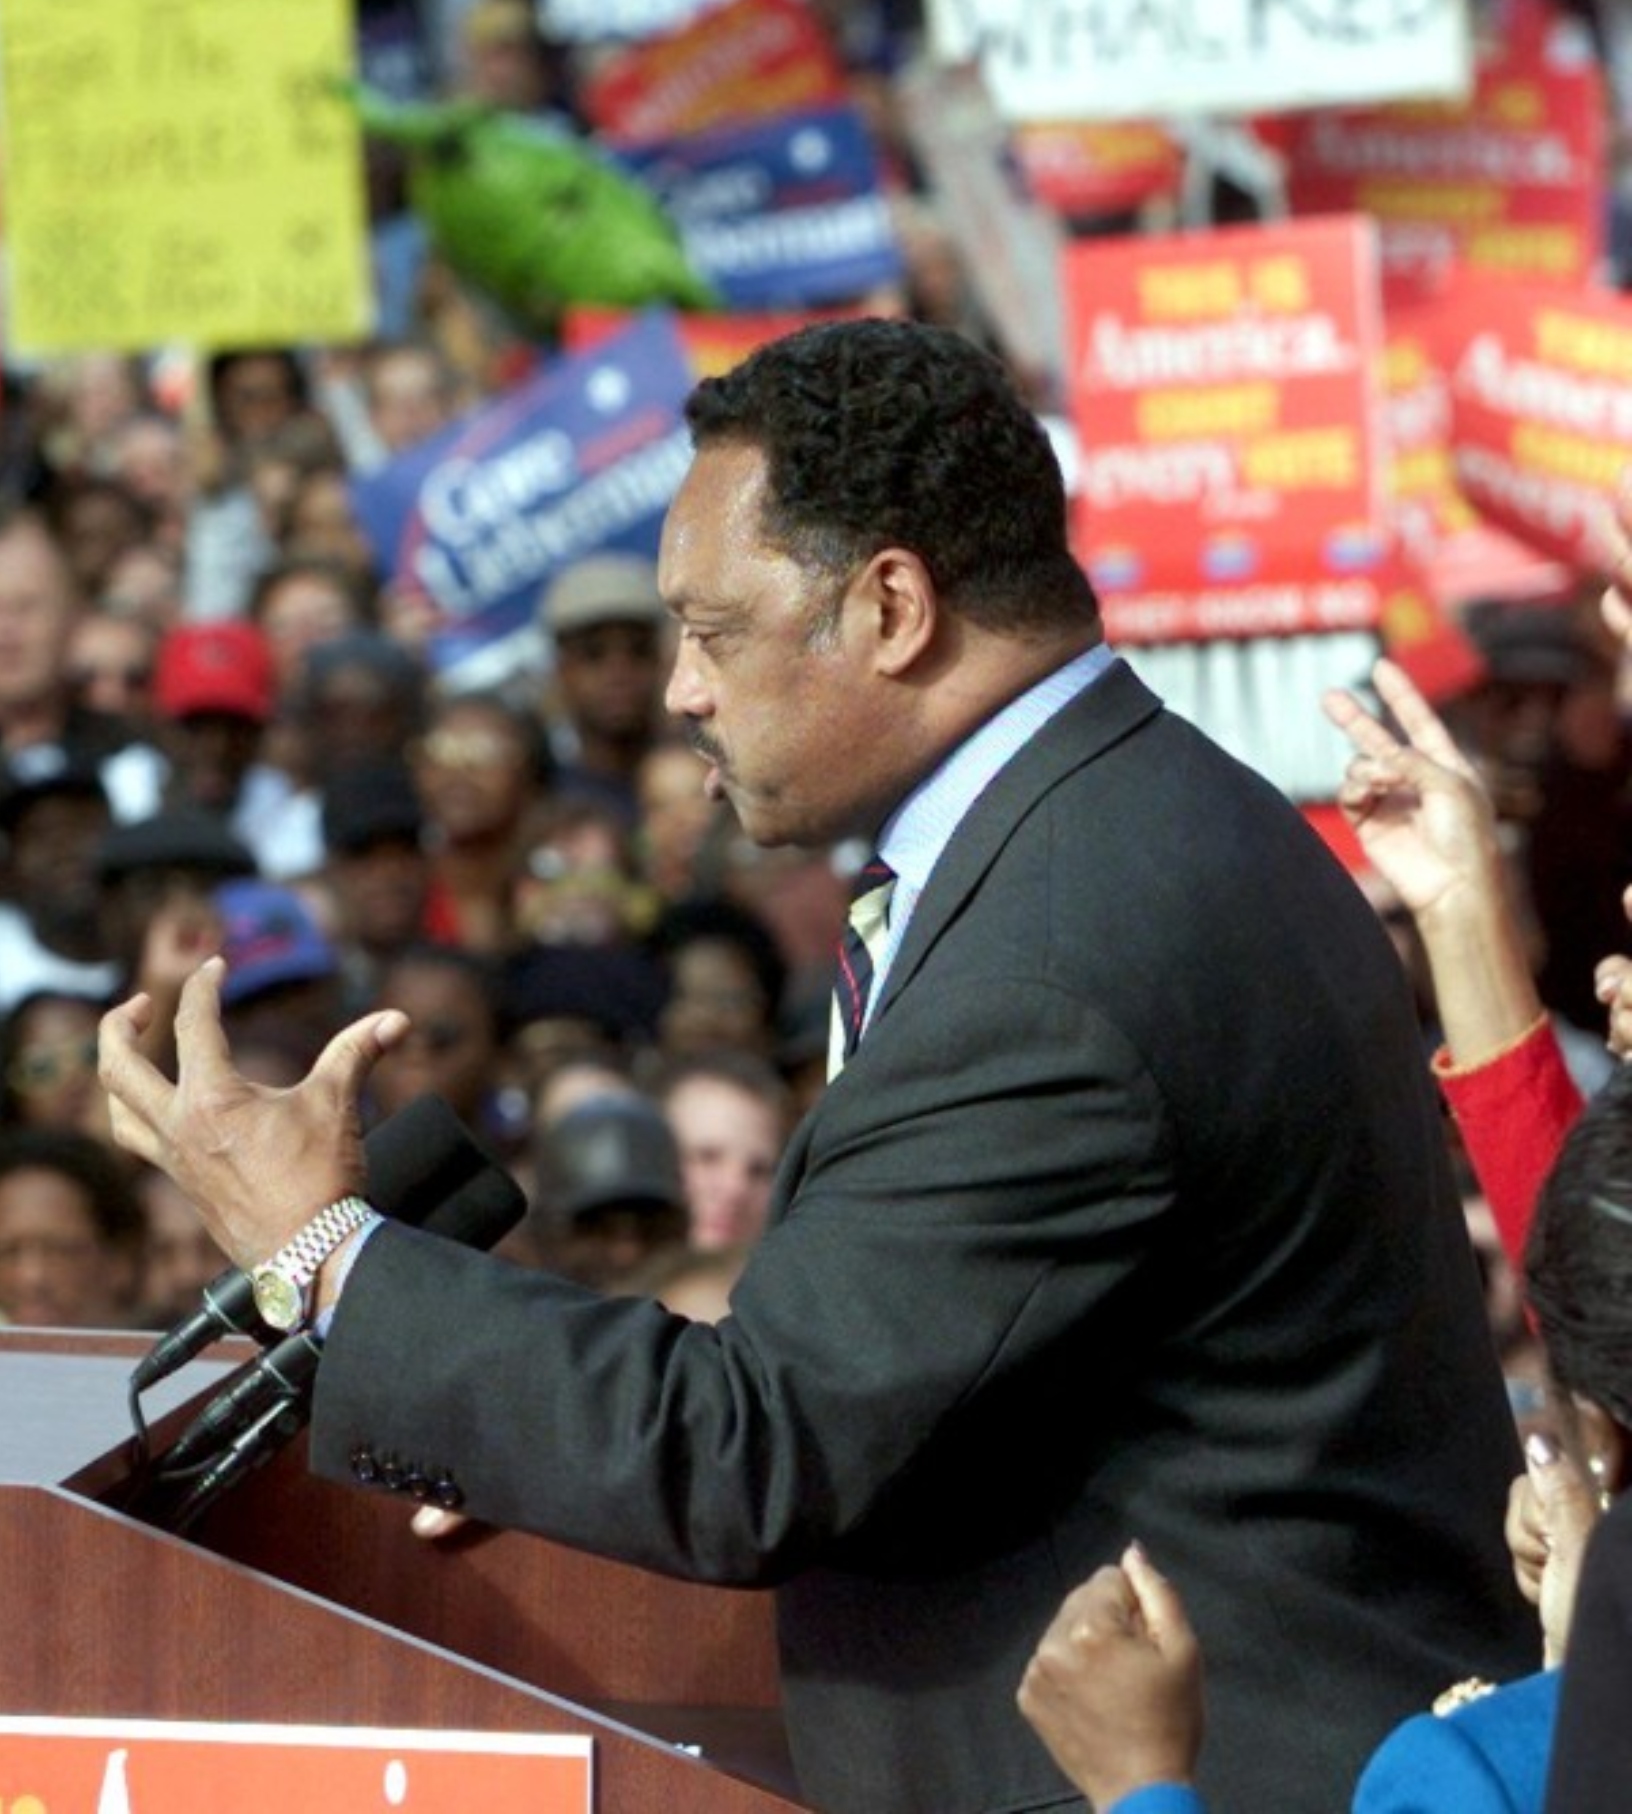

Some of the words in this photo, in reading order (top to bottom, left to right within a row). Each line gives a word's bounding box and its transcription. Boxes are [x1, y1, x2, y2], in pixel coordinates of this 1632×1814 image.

[1138, 260, 1241, 320] THIS
[1248, 252, 1308, 314] IS
[1080, 306, 1358, 392] America.
[1137, 383, 1278, 443] COUNT
[420, 425, 575, 552] Gore
[1241, 427, 1358, 493] VOTE
